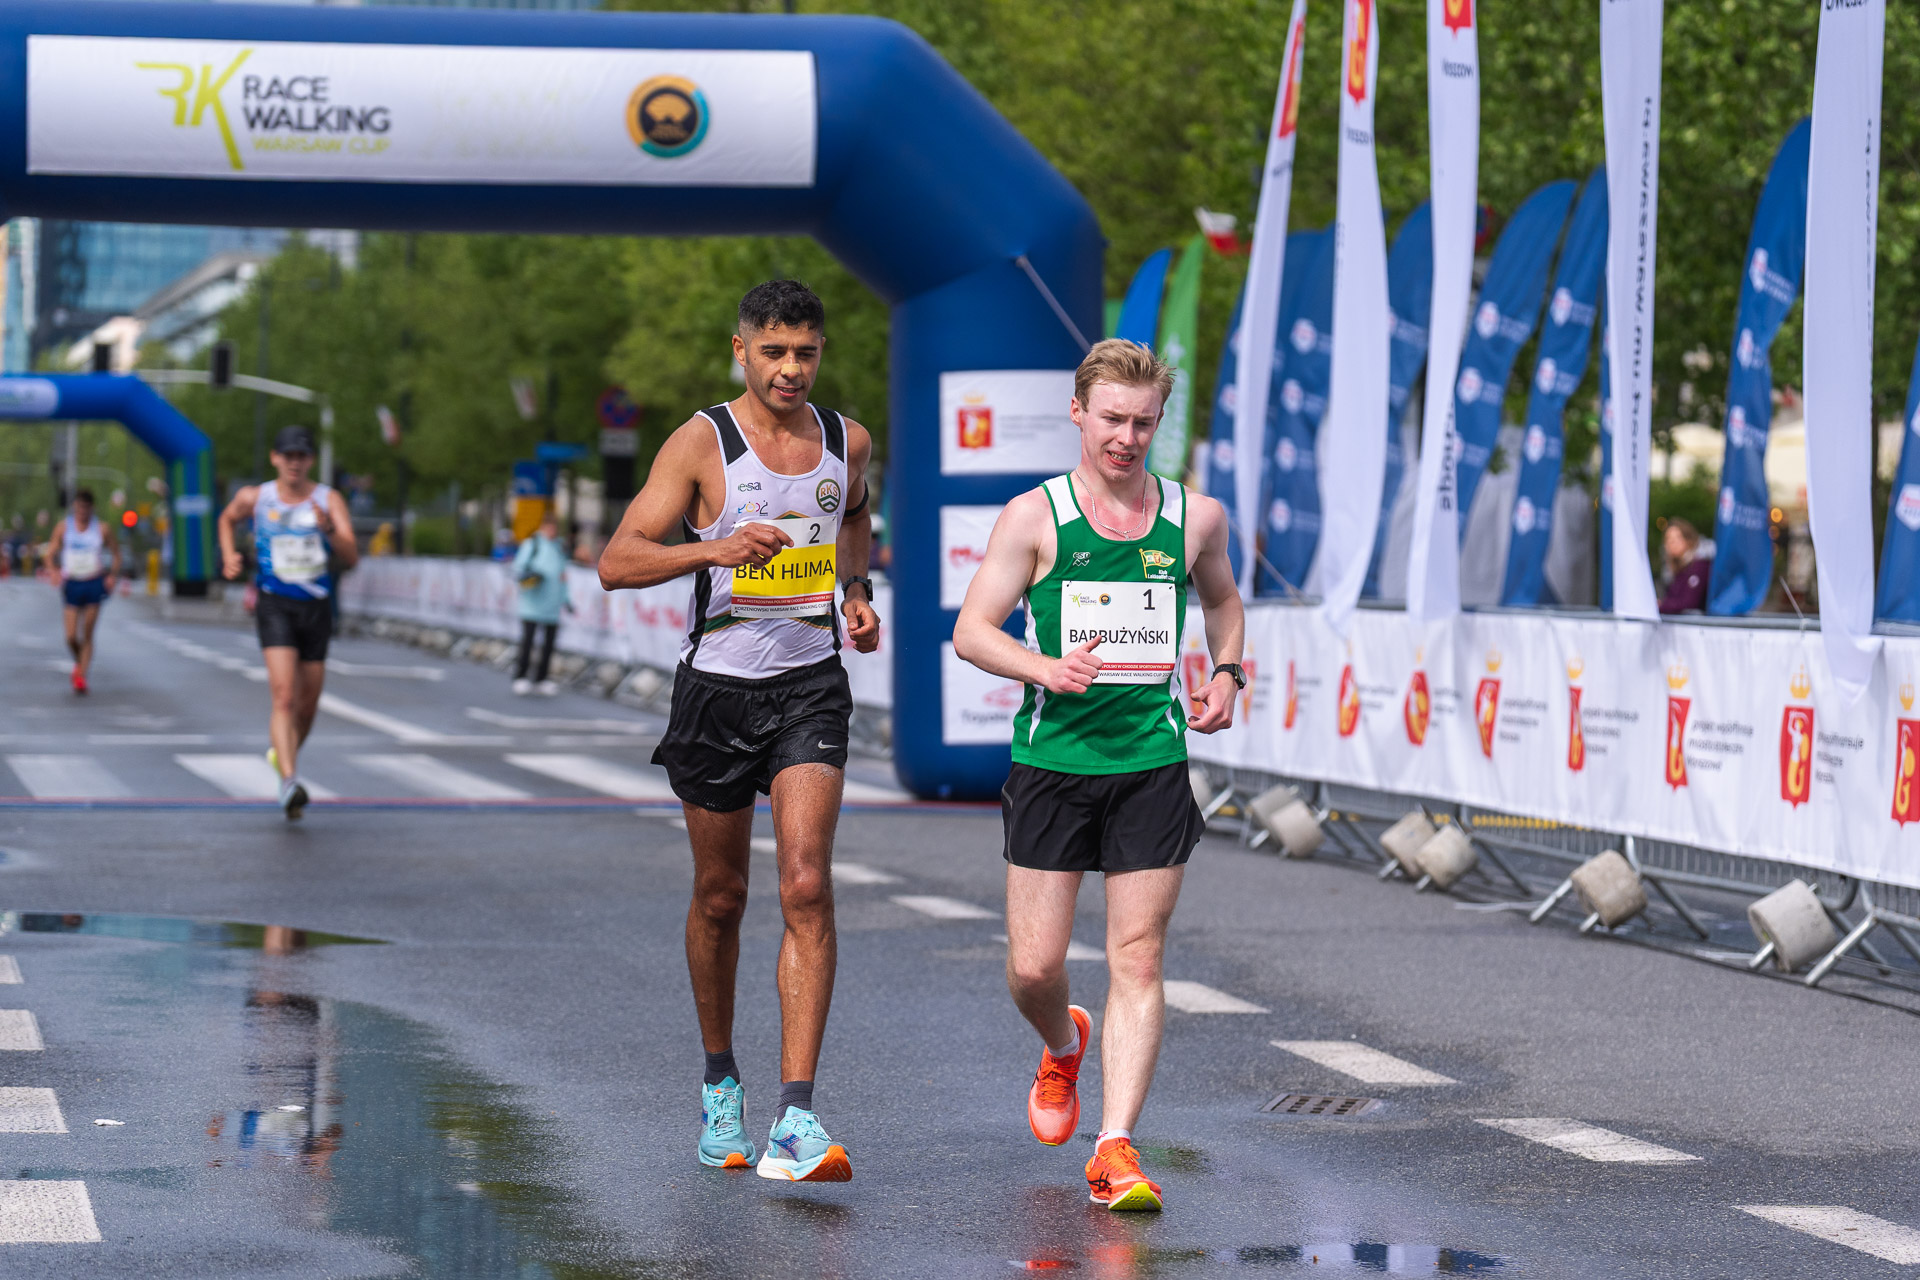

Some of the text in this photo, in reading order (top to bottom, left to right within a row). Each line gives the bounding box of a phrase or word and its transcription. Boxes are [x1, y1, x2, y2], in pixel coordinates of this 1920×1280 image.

[243, 75, 329, 102] RACE
[243, 105, 391, 133] WALKING
[254, 136, 391, 154] WARSAW CUP
[820, 483, 838, 497] RKS
[809, 523, 821, 544] 2
[735, 559, 834, 580] BEN HLIMA
[1143, 589, 1156, 610] 1
[1069, 627, 1169, 645] BARBUŻYŃSKI
